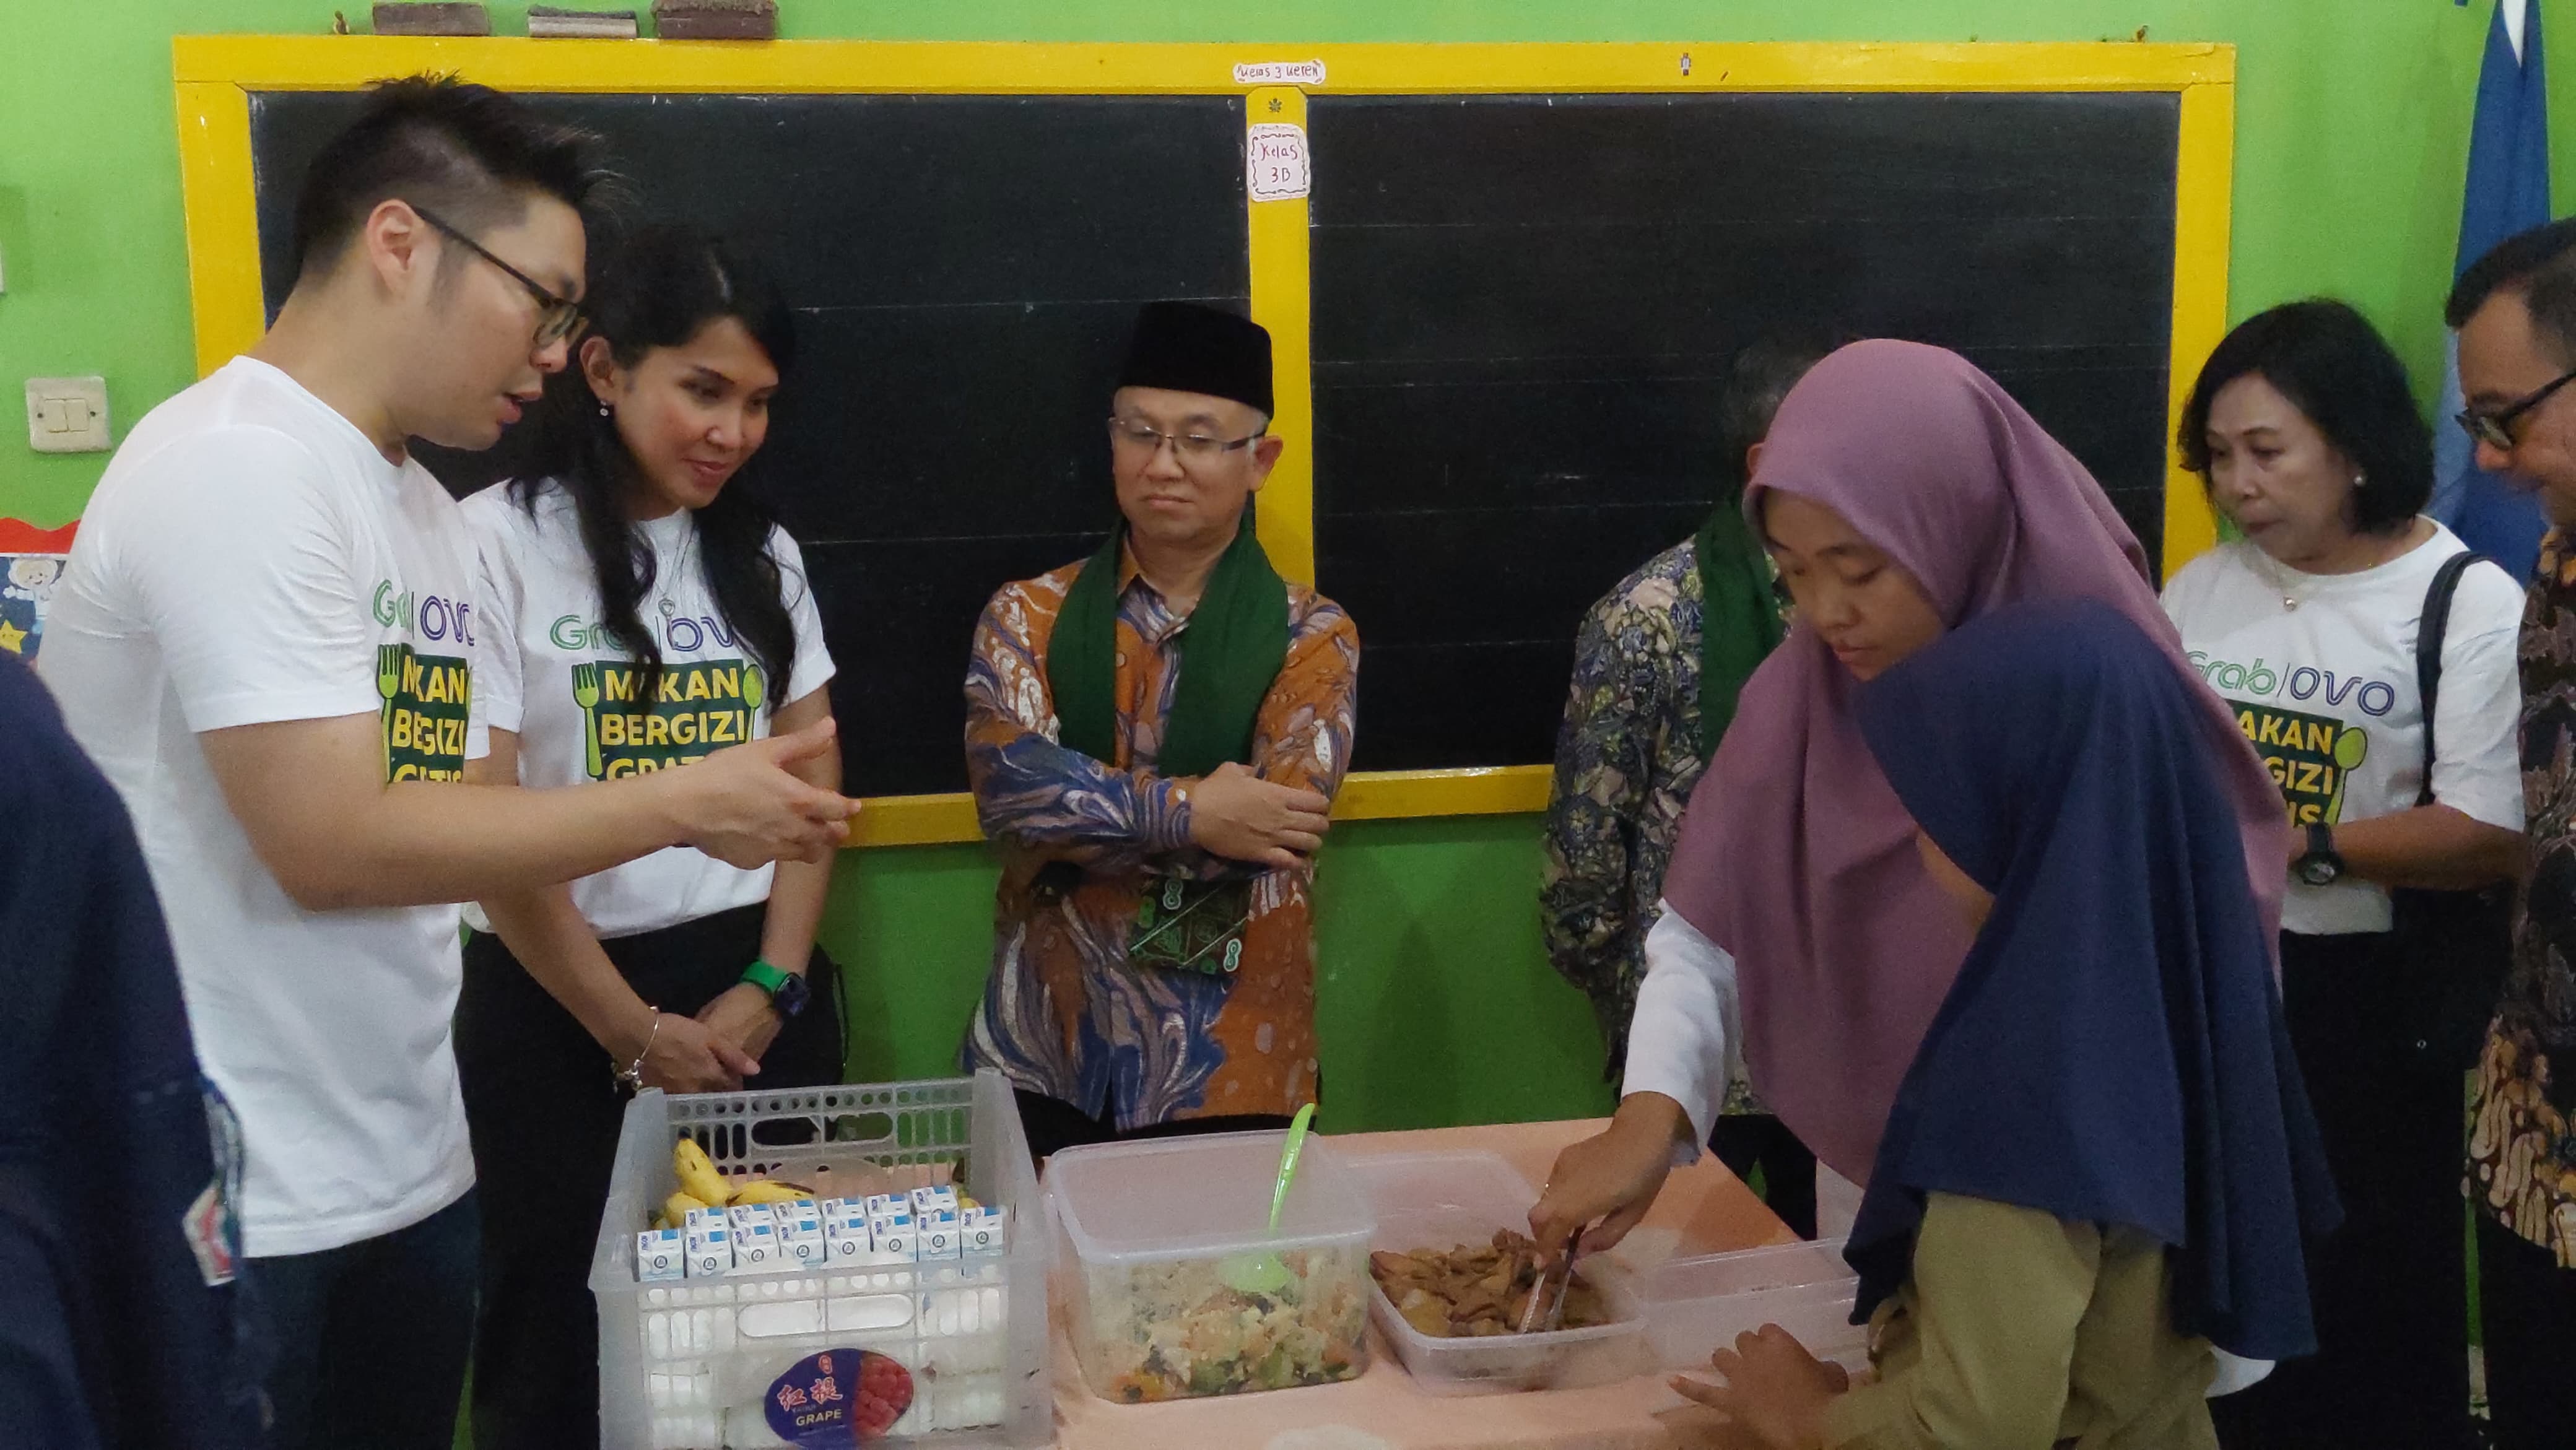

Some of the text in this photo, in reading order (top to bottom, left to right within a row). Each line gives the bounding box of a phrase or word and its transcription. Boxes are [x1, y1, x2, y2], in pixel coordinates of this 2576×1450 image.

[1275, 66, 1282, 79] 3
[604, 667, 740, 703] MKAN
[2290, 666, 2395, 716] OVO
[601, 710, 745, 746] BERGIZI
[2237, 710, 2334, 755] AKAN
[2263, 756, 2334, 796] GIZI
[777, 1376, 843, 1412] 红提
[795, 1409, 843, 1427] GRAPE
